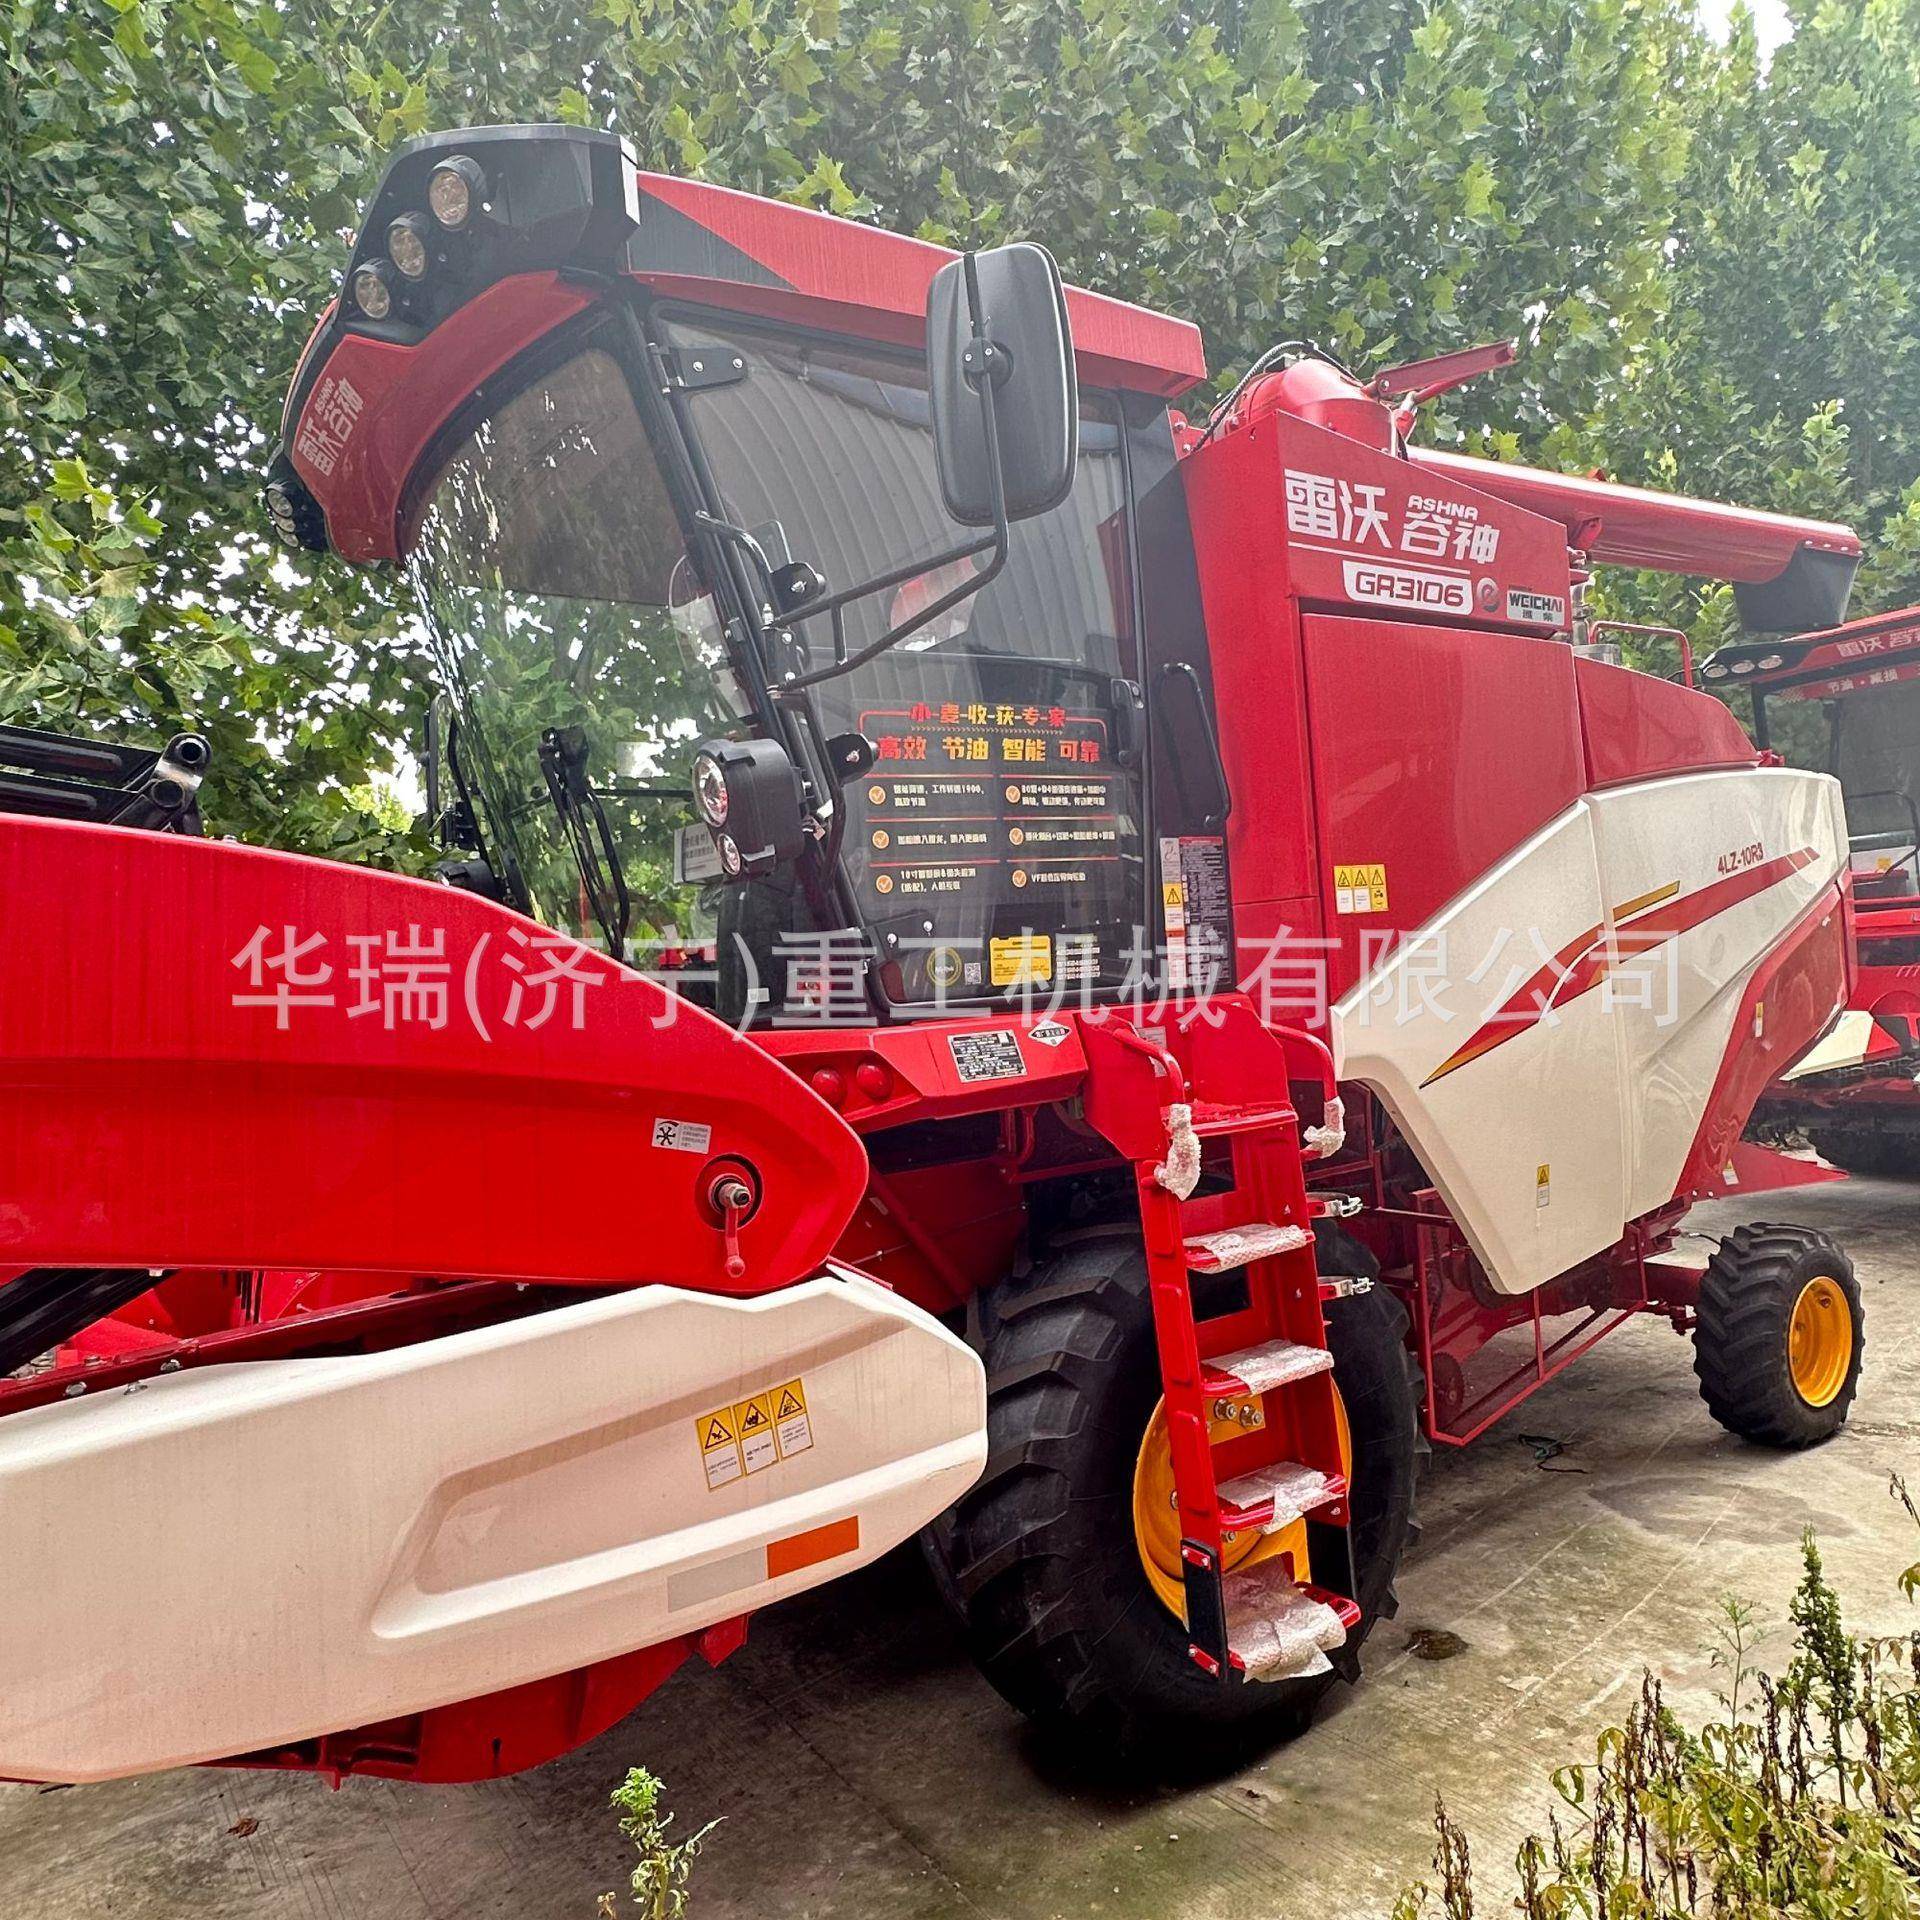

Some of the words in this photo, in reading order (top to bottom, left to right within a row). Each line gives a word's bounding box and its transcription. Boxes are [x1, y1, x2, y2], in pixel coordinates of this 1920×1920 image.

[297, 417, 343, 476] 雷沃
[323, 377, 363, 442] 谷神
[1284, 468, 1392, 548] 雷沃
[1399, 511, 1501, 565] 谷神
[1407, 494, 1480, 520] ASHNA
[1355, 570, 1465, 607] GR3106
[1509, 592, 1562, 613] WEICHAI
[877, 736, 927, 761] 高效
[942, 737, 989, 761] 节油
[1002, 738, 1046, 762] 智能
[1059, 739, 1100, 763] 可靠
[1717, 842, 1764, 875] 4LZ-10R3
